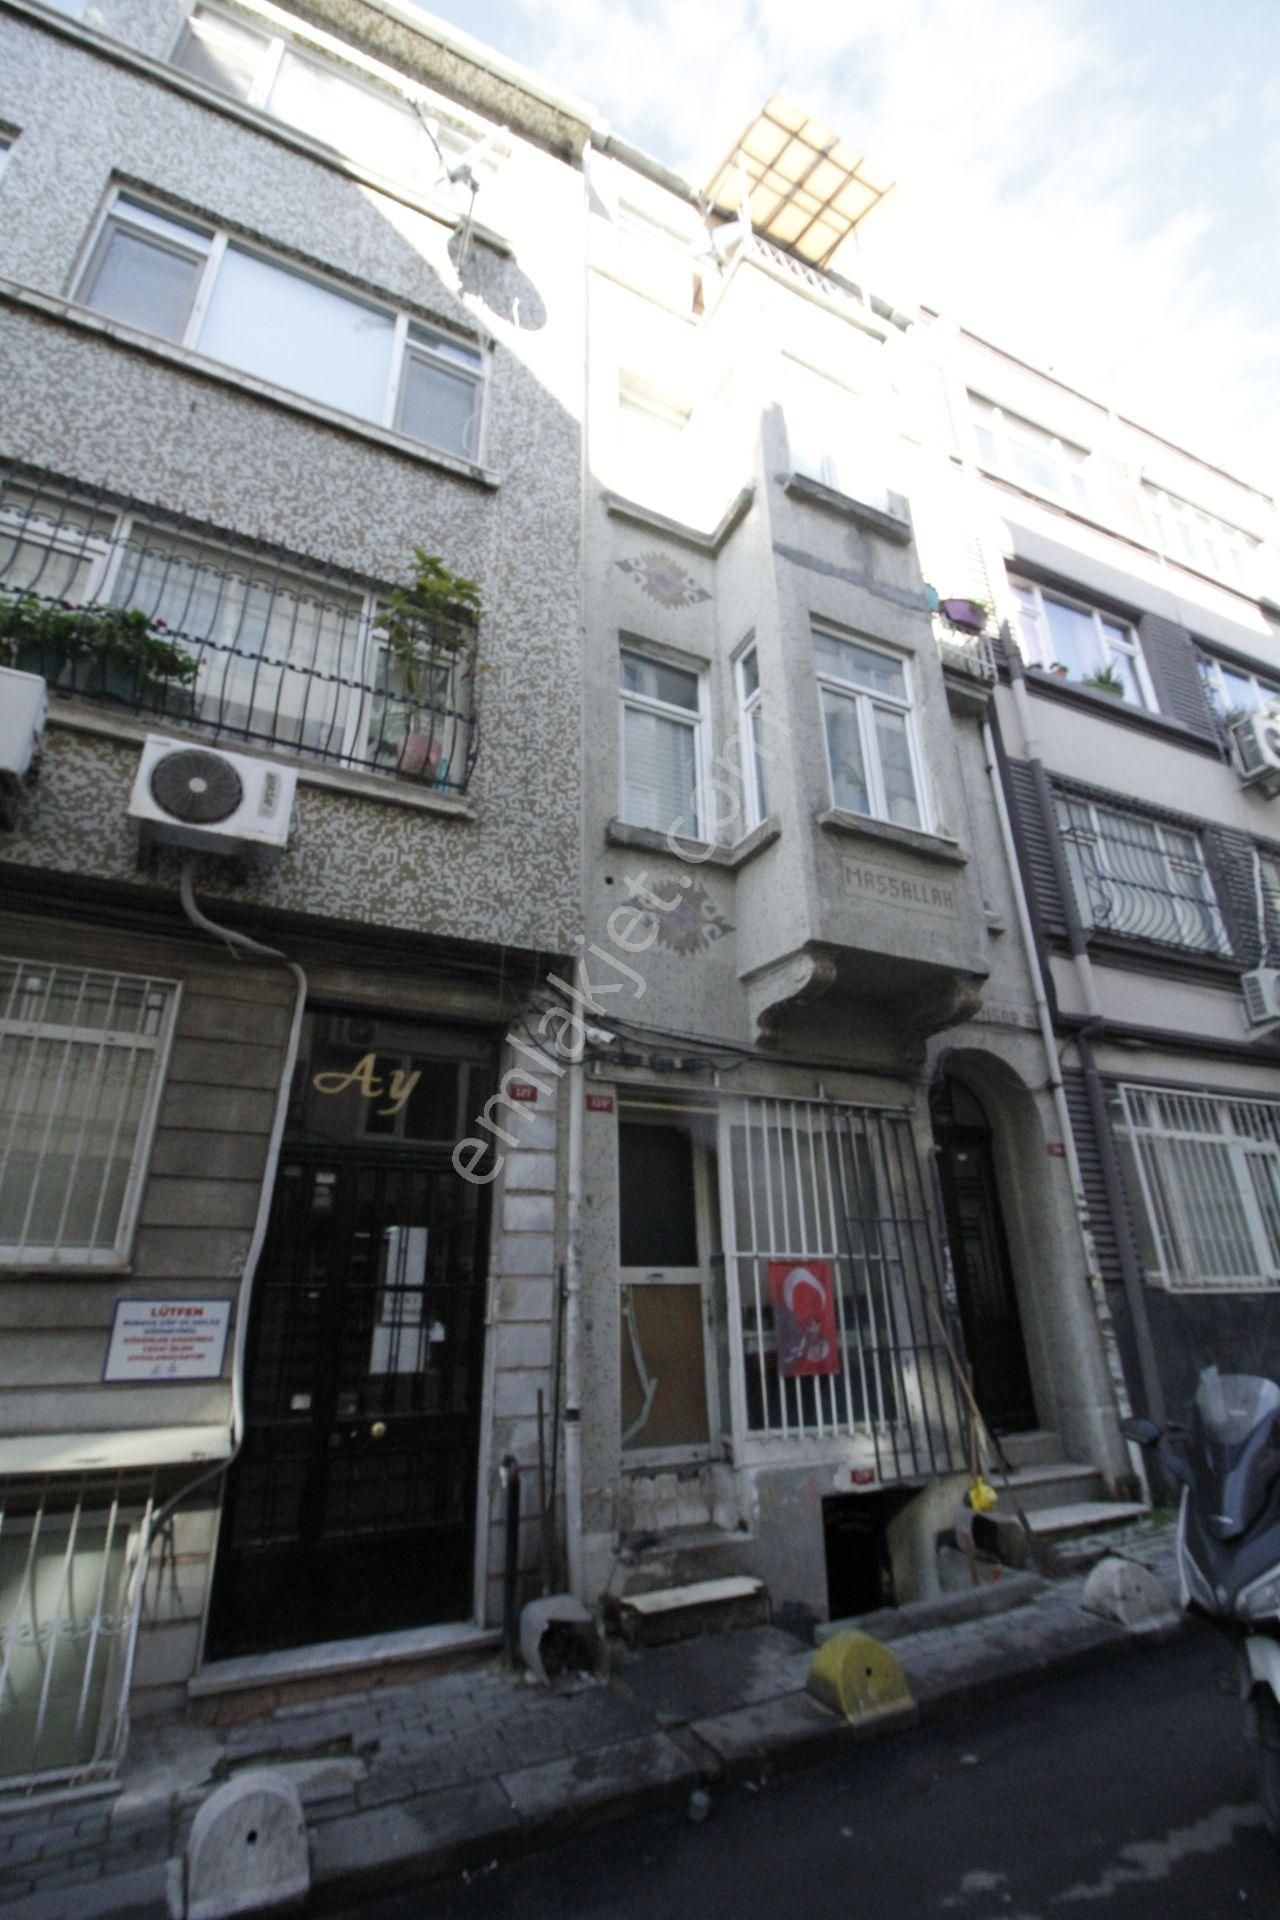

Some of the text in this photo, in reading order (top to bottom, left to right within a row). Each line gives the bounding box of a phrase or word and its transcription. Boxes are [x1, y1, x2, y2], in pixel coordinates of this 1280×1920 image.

[845, 865, 954, 910] MASSALLAH
[313, 1052, 422, 1116] Ay
[150, 1304, 205, 1317] LÜTFEN
